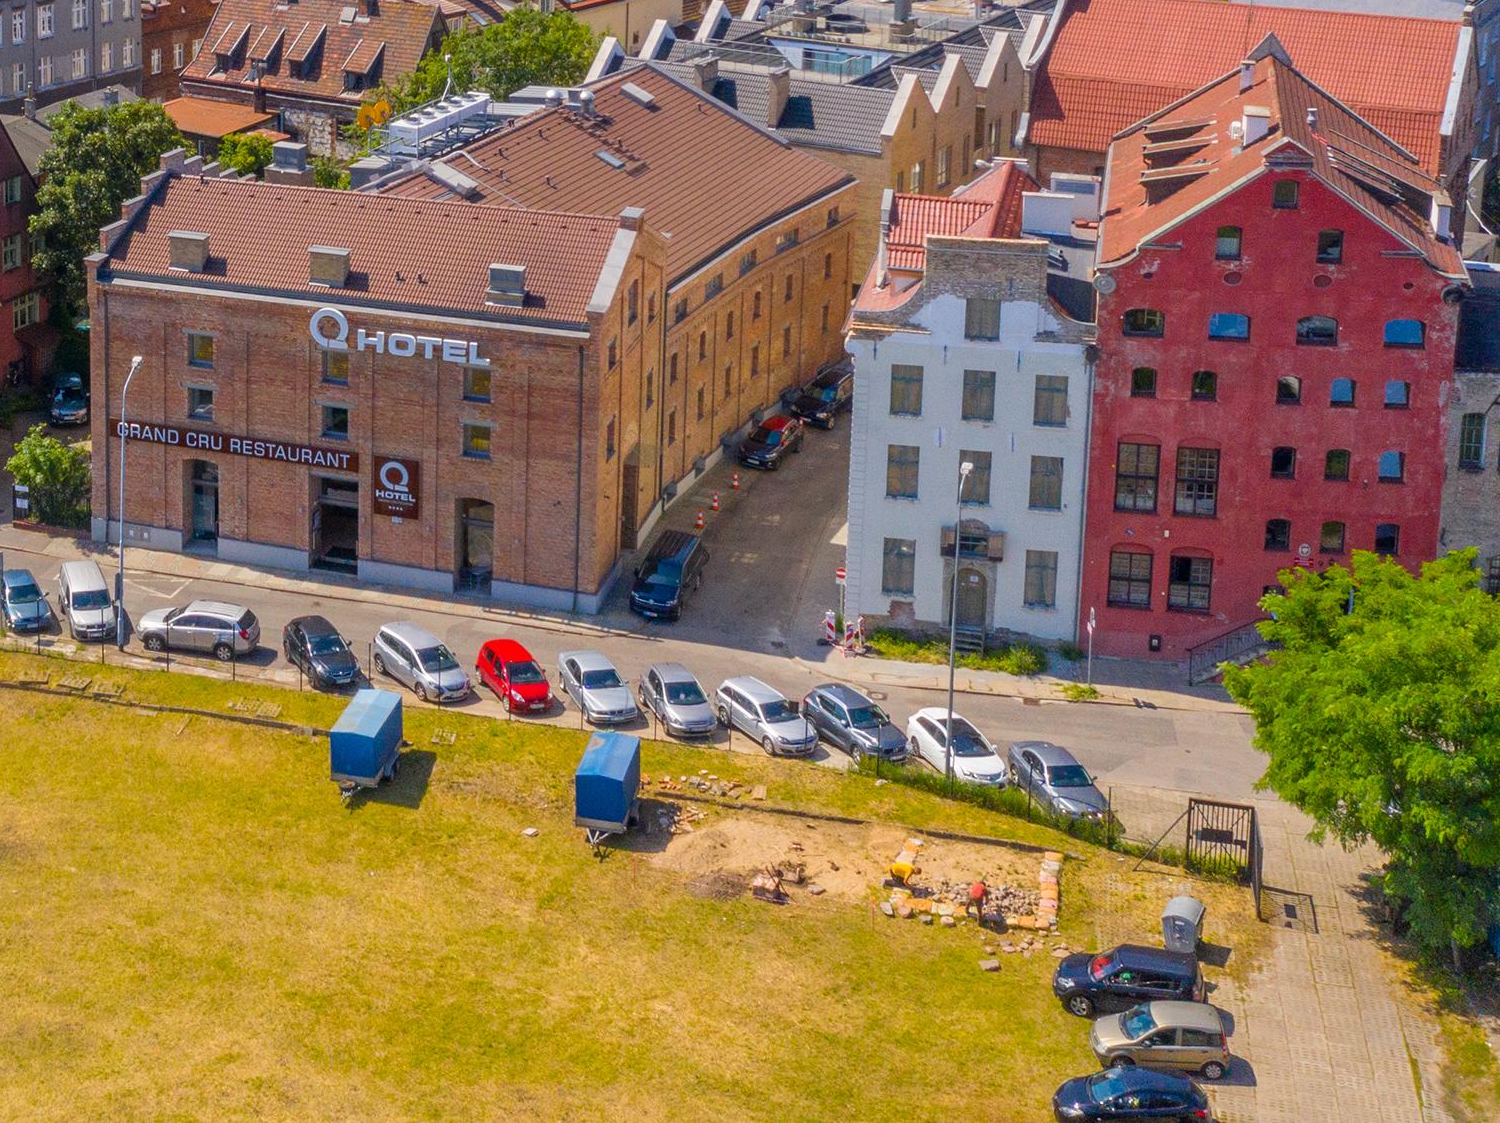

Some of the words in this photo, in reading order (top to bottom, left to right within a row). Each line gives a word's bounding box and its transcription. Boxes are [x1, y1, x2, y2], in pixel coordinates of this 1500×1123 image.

[309, 307, 349, 350] Q
[357, 328, 491, 366] HOTEL
[116, 421, 180, 445] GRAND
[185, 432, 222, 450] CRU
[229, 438, 351, 469] RESTAURANT
[375, 489, 417, 503] HOTEL
[380, 461, 409, 493] Q
